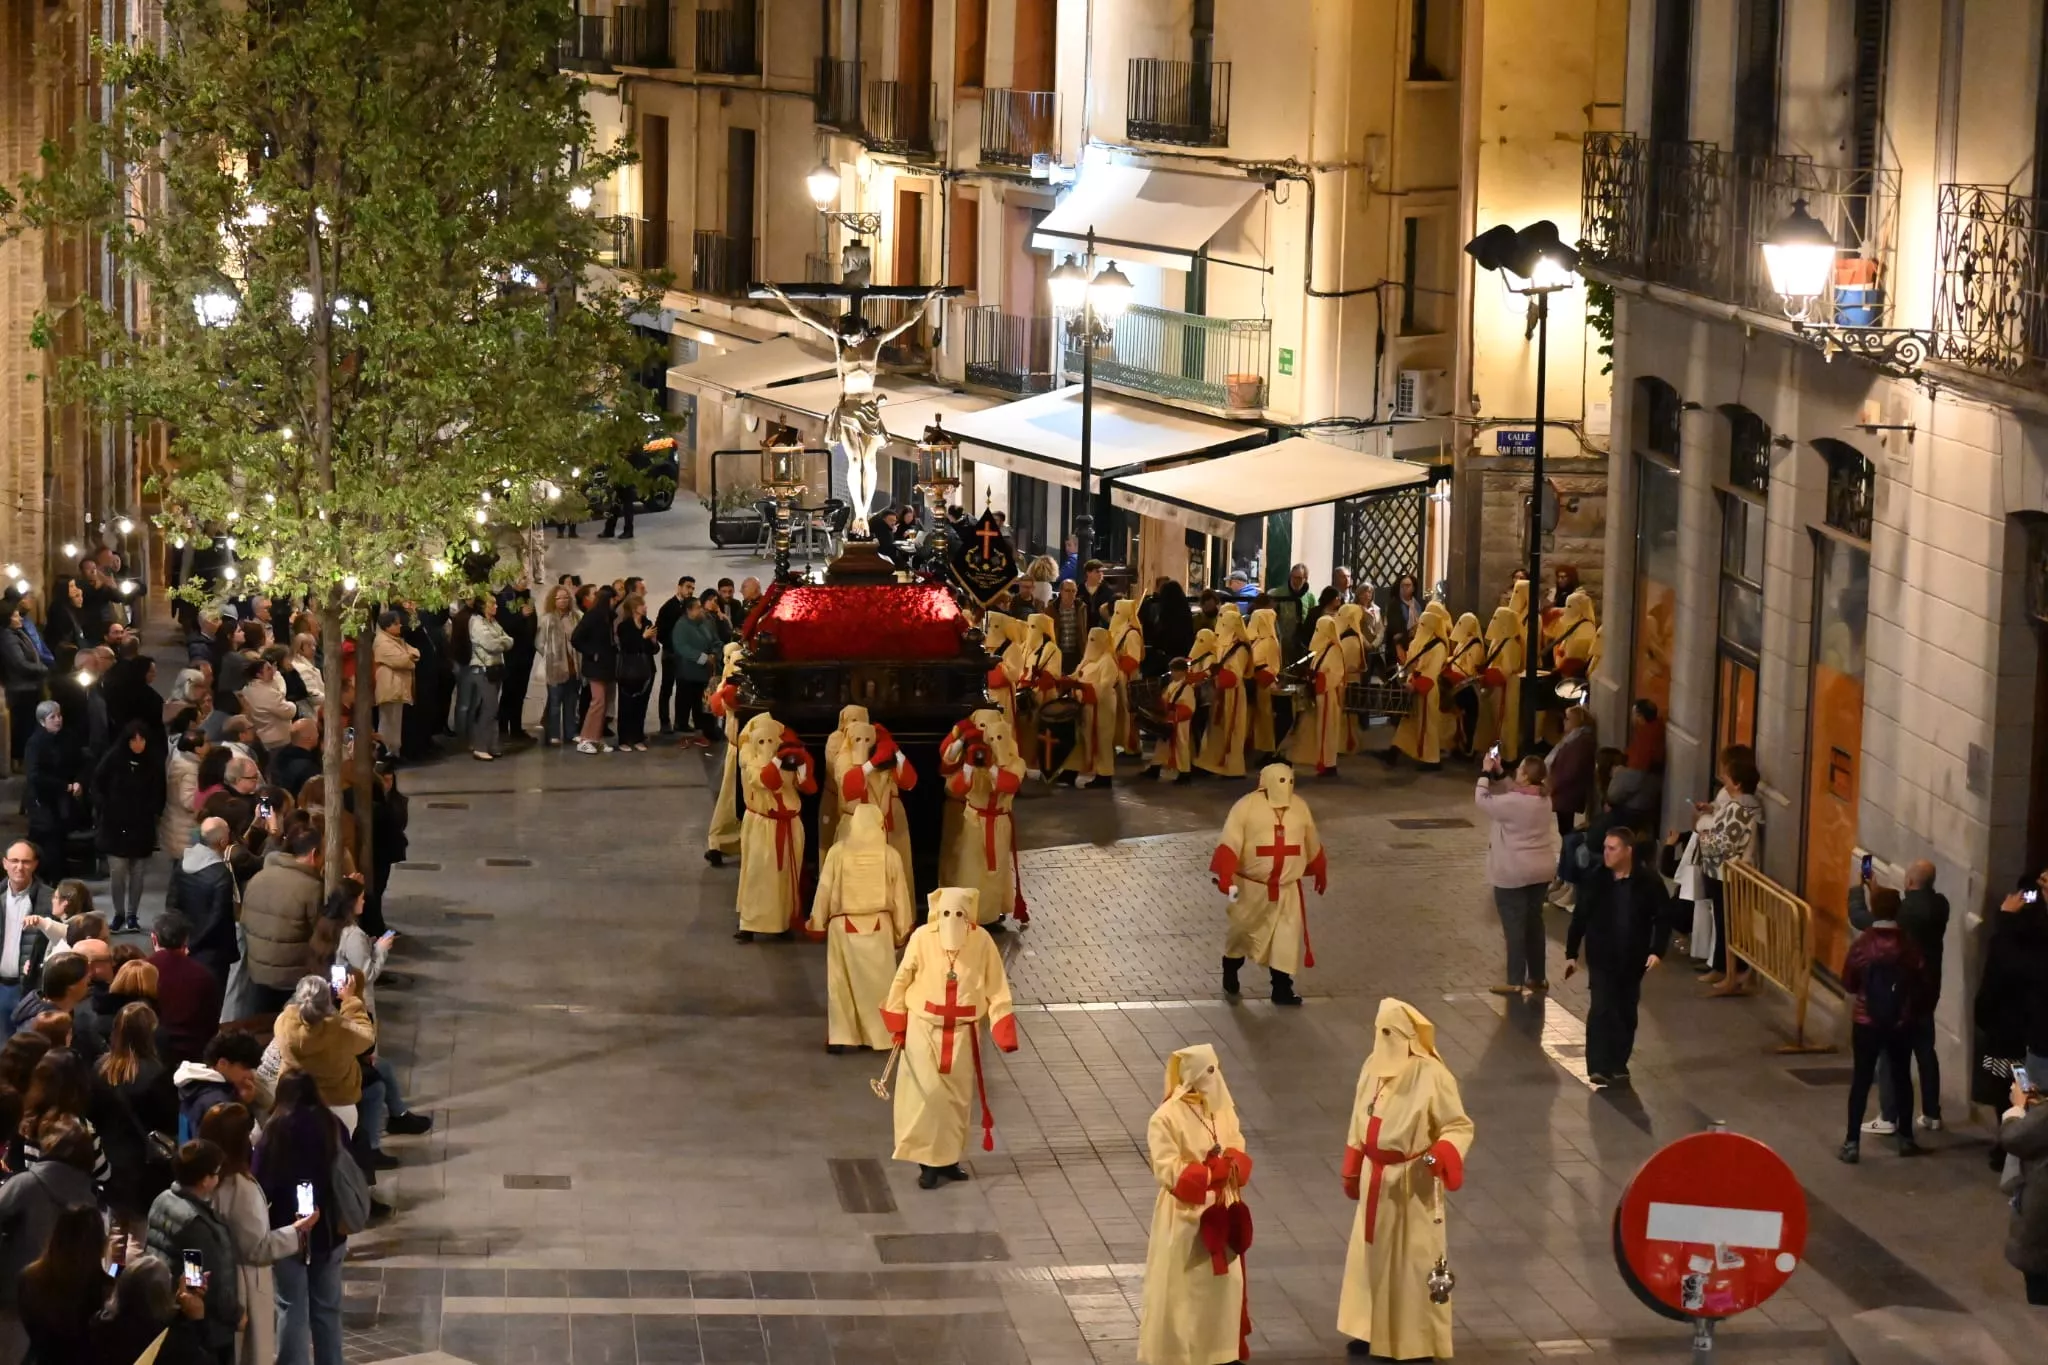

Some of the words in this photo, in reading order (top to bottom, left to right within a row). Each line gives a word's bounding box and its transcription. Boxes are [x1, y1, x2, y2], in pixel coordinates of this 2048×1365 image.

[1507, 432, 1531, 441] CALLE
[1498, 446, 1511, 456] SAN
[1512, 446, 1536, 456] ORENCI
